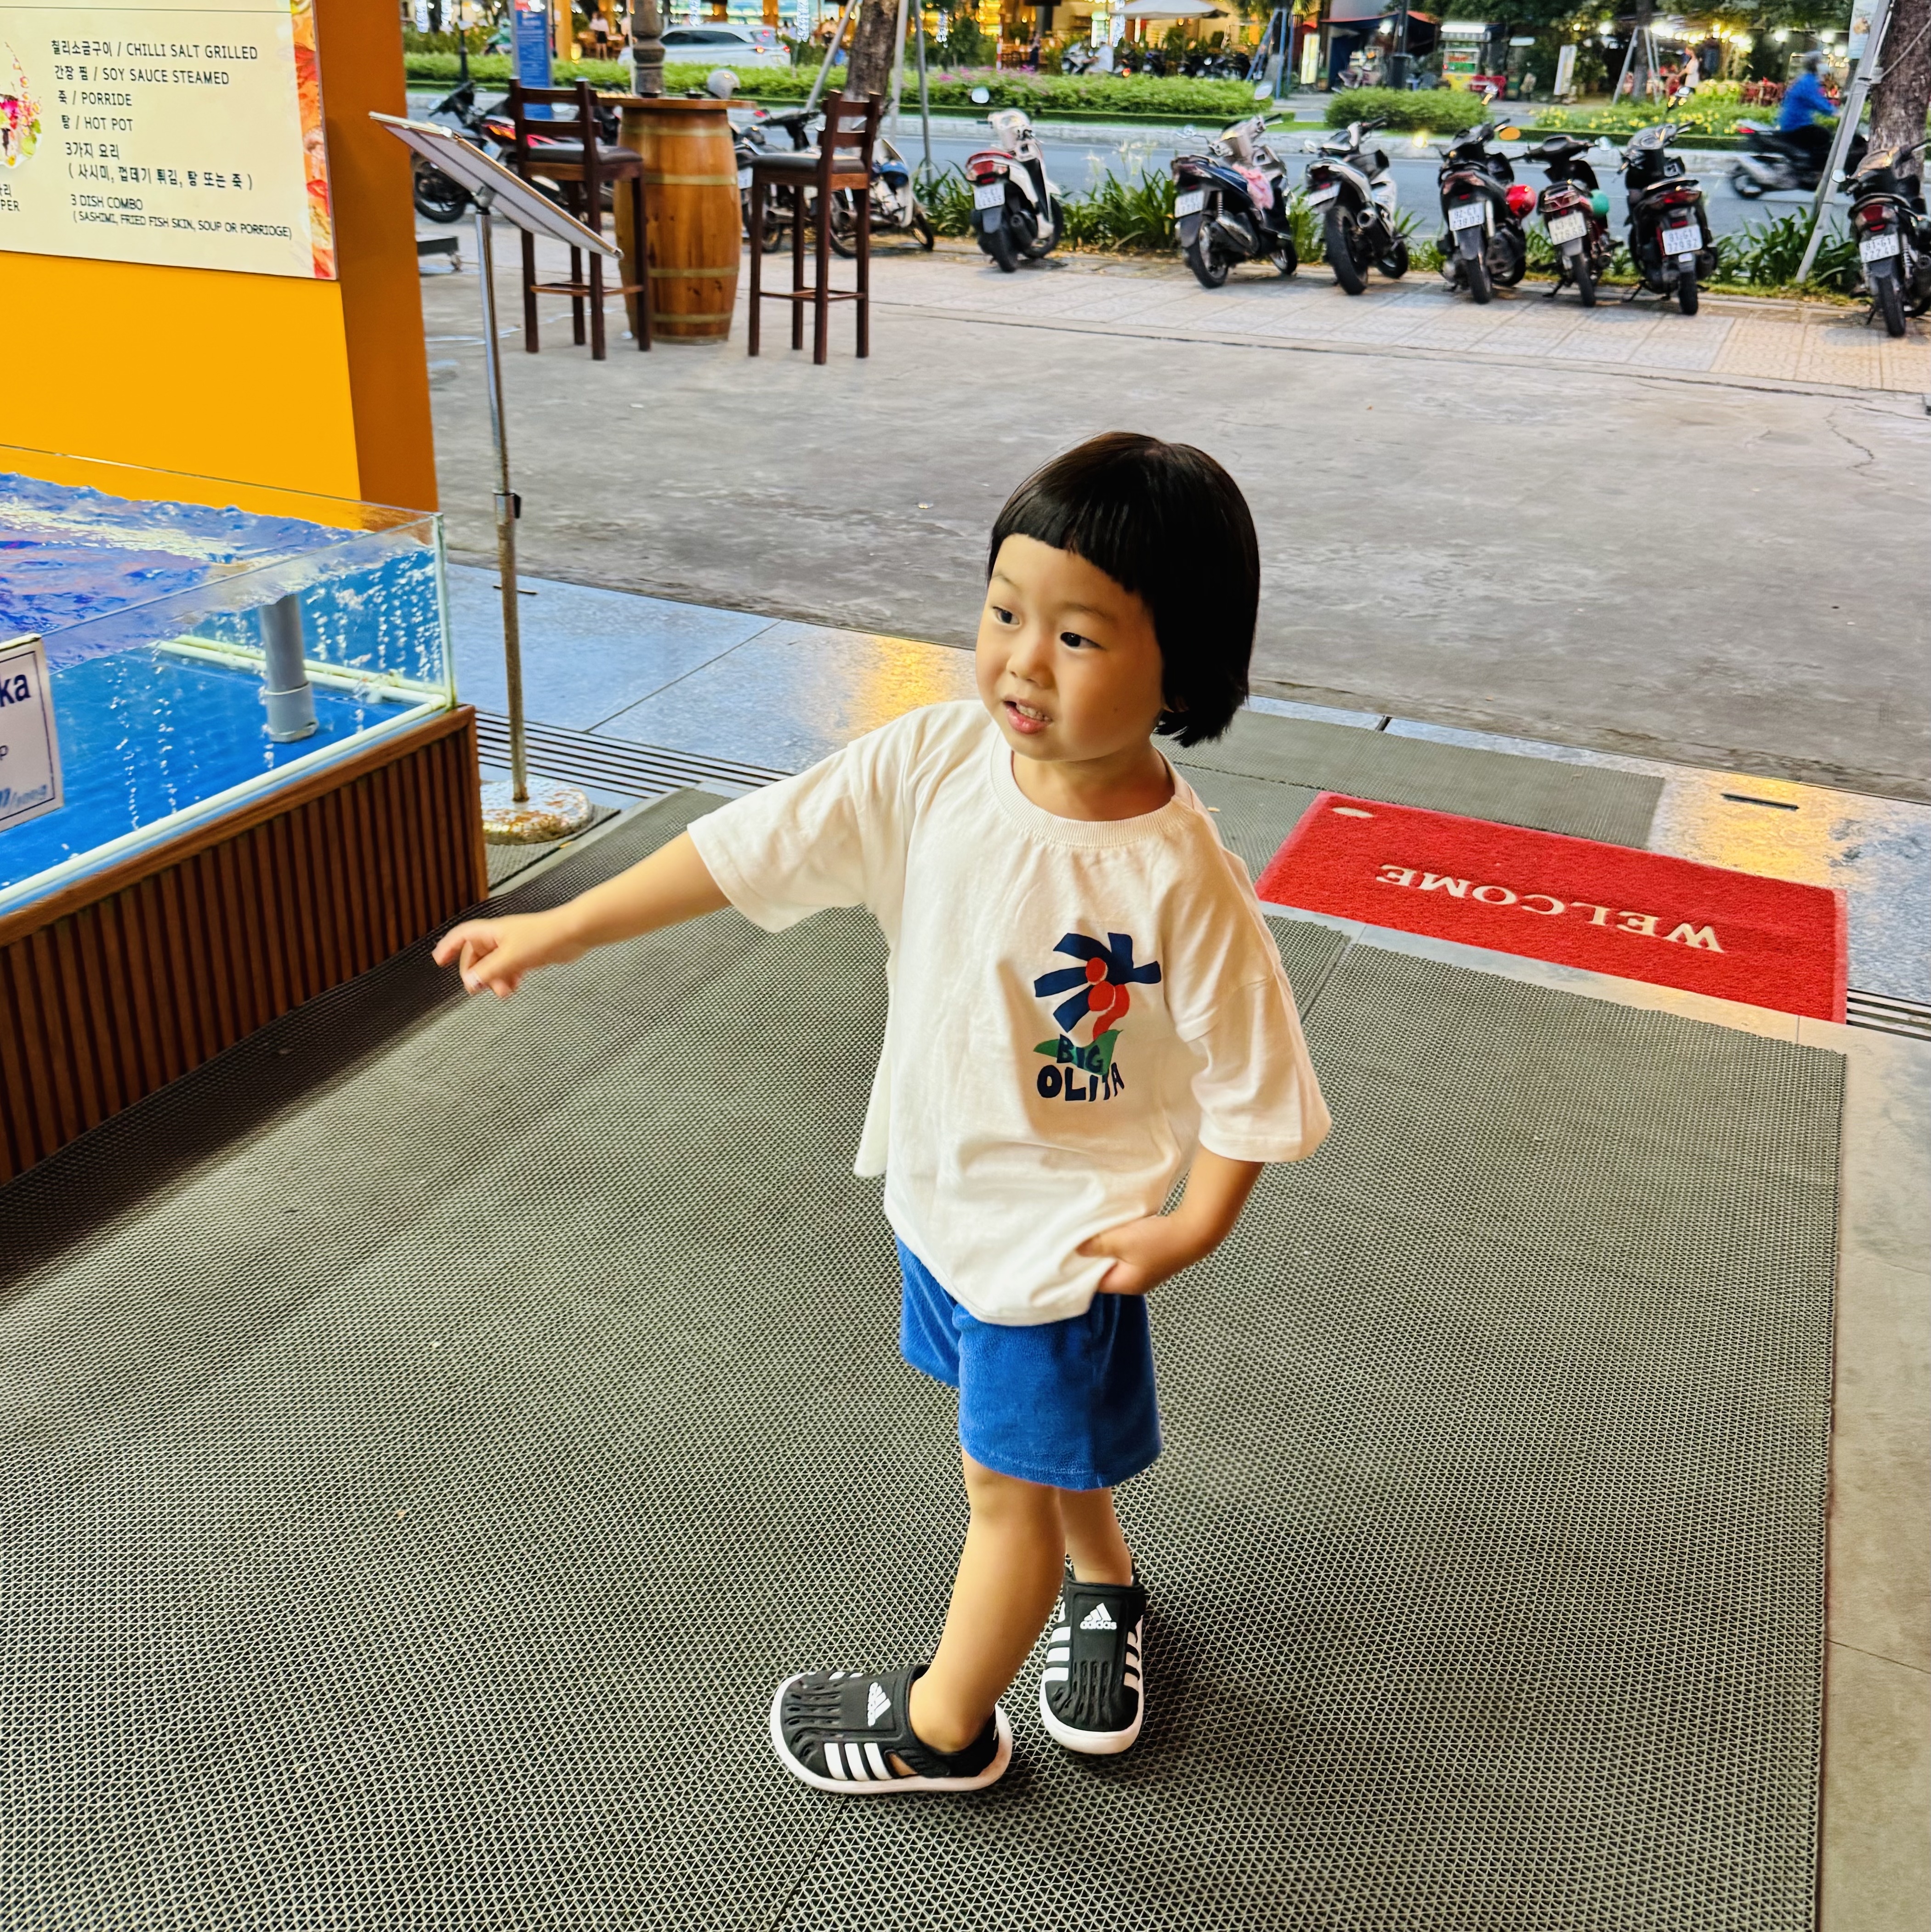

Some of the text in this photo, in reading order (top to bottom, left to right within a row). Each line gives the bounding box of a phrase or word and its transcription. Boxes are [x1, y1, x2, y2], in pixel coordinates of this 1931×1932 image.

[51, 40, 112, 57] 칠리소금구이
[126, 43, 166, 57] CHILLI
[170, 44, 200, 58] SALT
[205, 45, 258, 59] GRILLED
[55, 65, 74, 80] 간장
[79, 66, 88, 80] 찜
[102, 68, 124, 81] SOY
[130, 68, 169, 83] SAUCE
[172, 70, 229, 85] STEAMED
[58, 90, 67, 104] 죽
[81, 92, 132, 106] PORRIDE
[61, 115, 70, 129] 탕
[84, 116, 106, 130] HOT
[111, 118, 133, 131] POT
[65, 142, 119, 160] 3가지 요리
[118, 166, 152, 184] 껍데기
[187, 170, 198, 187] 탕
[204, 172, 227, 188] 또는
[231, 173, 242, 190] 죽
[0, 199, 20, 211] PER
[70, 193, 143, 210] 3 DISH COMBO
[79, 210, 119, 226] SASHIMI,
[120, 214, 146, 226] FRIED
[148, 216, 170, 227] FISH
[198, 220, 222, 232] SOUP
[225, 222, 238, 233] OR
[1376, 864, 1725, 953] WELCOME
[1056, 1034, 1103, 1073] BIG
[1080, 1619, 1117, 1630] adidas
